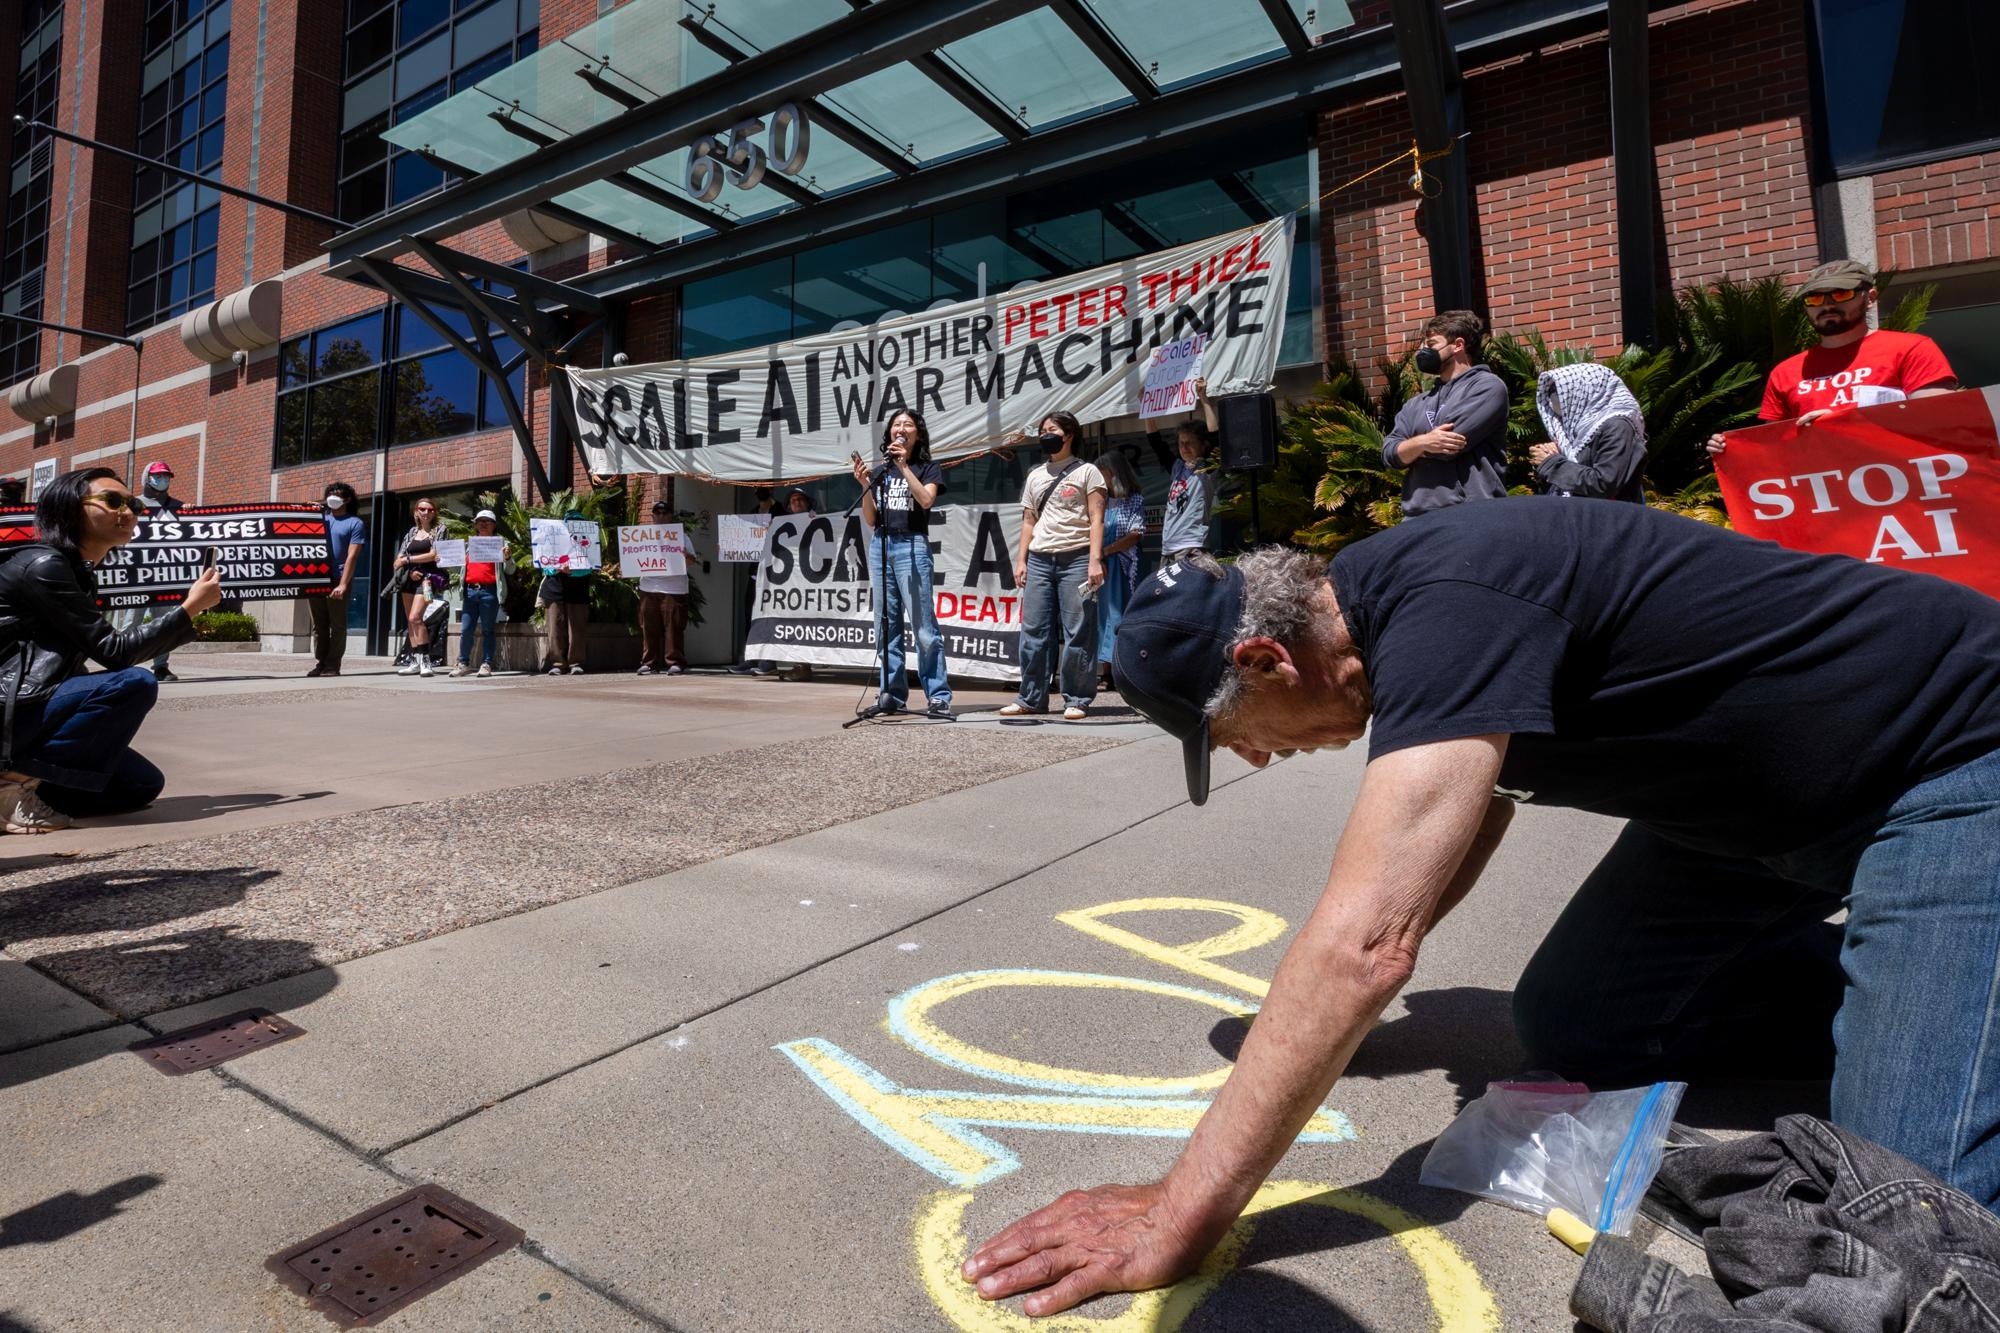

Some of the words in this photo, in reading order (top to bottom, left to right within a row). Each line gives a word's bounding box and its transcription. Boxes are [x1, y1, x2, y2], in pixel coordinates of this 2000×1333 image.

[686, 103, 810, 203] 650
[831, 315, 993, 382] ANOTHER
[1004, 285, 1128, 345] PETER
[1141, 235, 1270, 309] THIEL
[833, 367, 945, 428] WAR
[965, 276, 1269, 404] MACHINE
[1797, 367, 1872, 395] STOP
[576, 368, 740, 450] SCALE
[756, 351, 820, 440] AI
[1141, 379, 1198, 414] PHILIPPINES
[1829, 385, 1860, 407] AI
[1749, 454, 1969, 520] STOP
[886, 496, 915, 511] KOREA
[1144, 508, 1161, 516] VATE
[148, 522, 183, 540] IS
[189, 518, 267, 539] LIFE!
[1144, 516, 1164, 524] PERTY
[621, 528, 661, 543] SCALE
[663, 531, 678, 541] AI
[1865, 508, 1969, 562] AI
[141, 548, 202, 564] LAND
[622, 544, 658, 555] PROFITS
[660, 545, 682, 554] FROM
[724, 551, 763, 561] HUMANKIN
[766, 511, 947, 586] SCAE
[637, 557, 667, 568] WAR
[93, 568, 129, 586] HE
[136, 563, 276, 584] PHILIPINES
[110, 594, 150, 606] ICHRP
[239, 587, 300, 599] MOVEMENT
[760, 588, 851, 612] PROFITS
[935, 592, 1023, 624] DEAT
[774, 624, 864, 643] SPONSORED
[950, 635, 1010, 659] THIEL
